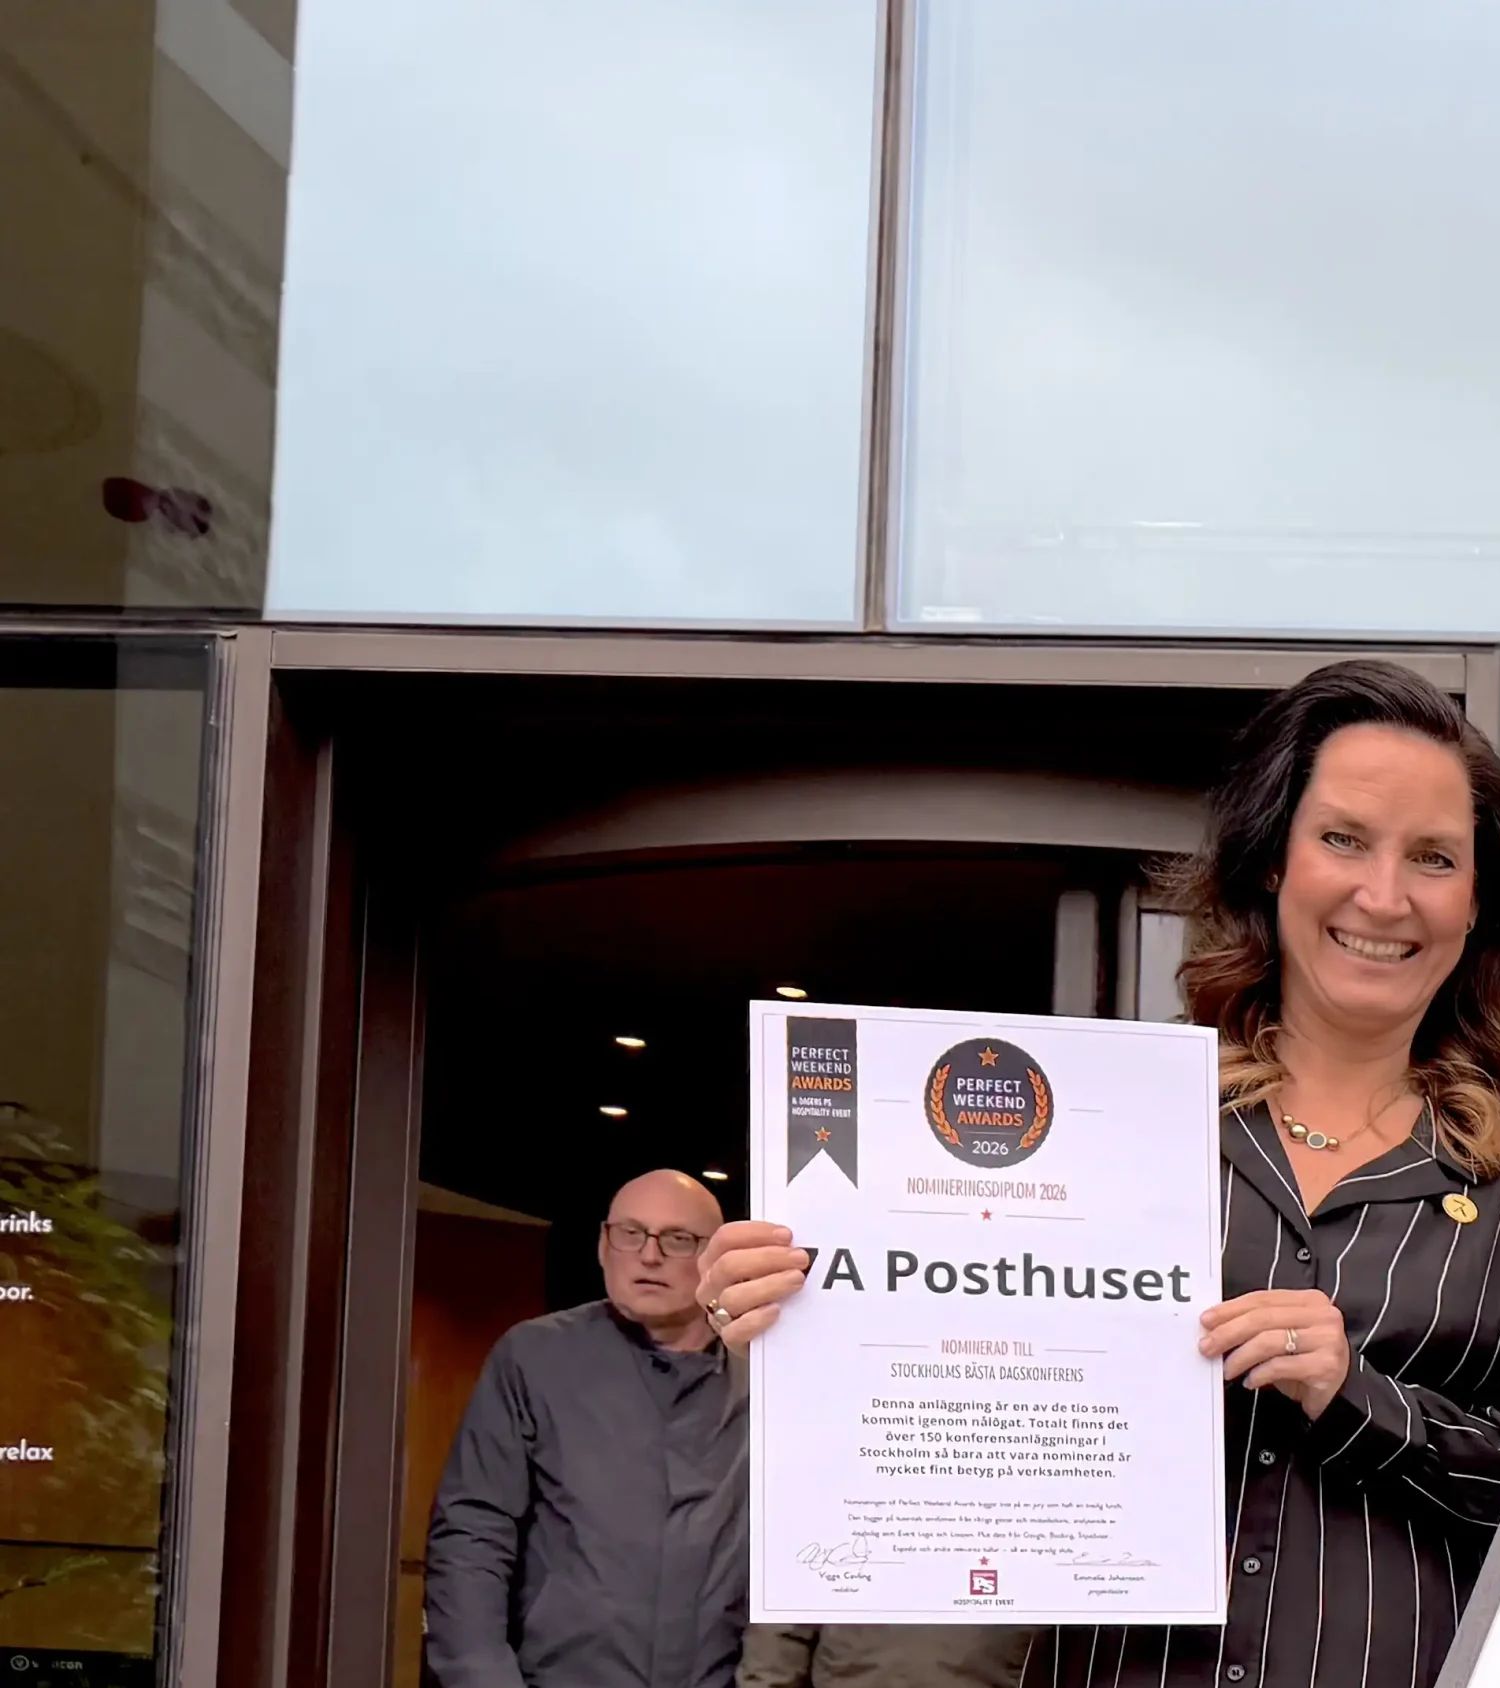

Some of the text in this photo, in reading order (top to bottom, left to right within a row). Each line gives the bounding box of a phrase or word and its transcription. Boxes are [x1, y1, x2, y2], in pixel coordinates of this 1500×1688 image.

[792, 1047, 848, 1060] PERFECT
[792, 1061, 851, 1074] WEEKEND
[792, 1076, 852, 1090] AWARDS
[957, 1078, 1021, 1094] PERFECT
[953, 1094, 1025, 1110] WEEKEND
[956, 1110, 1023, 1127] AWARDS
[972, 1140, 1008, 1156] 2026
[907, 1178, 1066, 1201] NOMINERINGSDIPLOM 2026
[0, 1211, 53, 1232] rinks
[887, 1250, 1191, 1302] Posthuset
[941, 1339, 1034, 1358] NOMINERAD TILL
[890, 1362, 1084, 1382] STOCKHOLMS BÄSTA DAGSKONFERENS
[872, 1398, 1119, 1414] Denna anläggning är en av de tio som
[862, 1414, 914, 1426] kommit
[918, 1415, 968, 1429] igenom
[1029, 1418, 1068, 1430] Totalt
[1072, 1418, 1104, 1430] finns
[1107, 1420, 1129, 1430] det
[886, 1430, 916, 1442] över
[920, 1432, 942, 1442] 150
[946, 1432, 1099, 1448] konferensanläggningar
[0, 1438, 54, 1460] relax
[860, 1446, 1132, 1462] Stockholm så bara att vara nominerad är
[876, 1464, 1116, 1478] mycket fint betyg på verksamheten.
